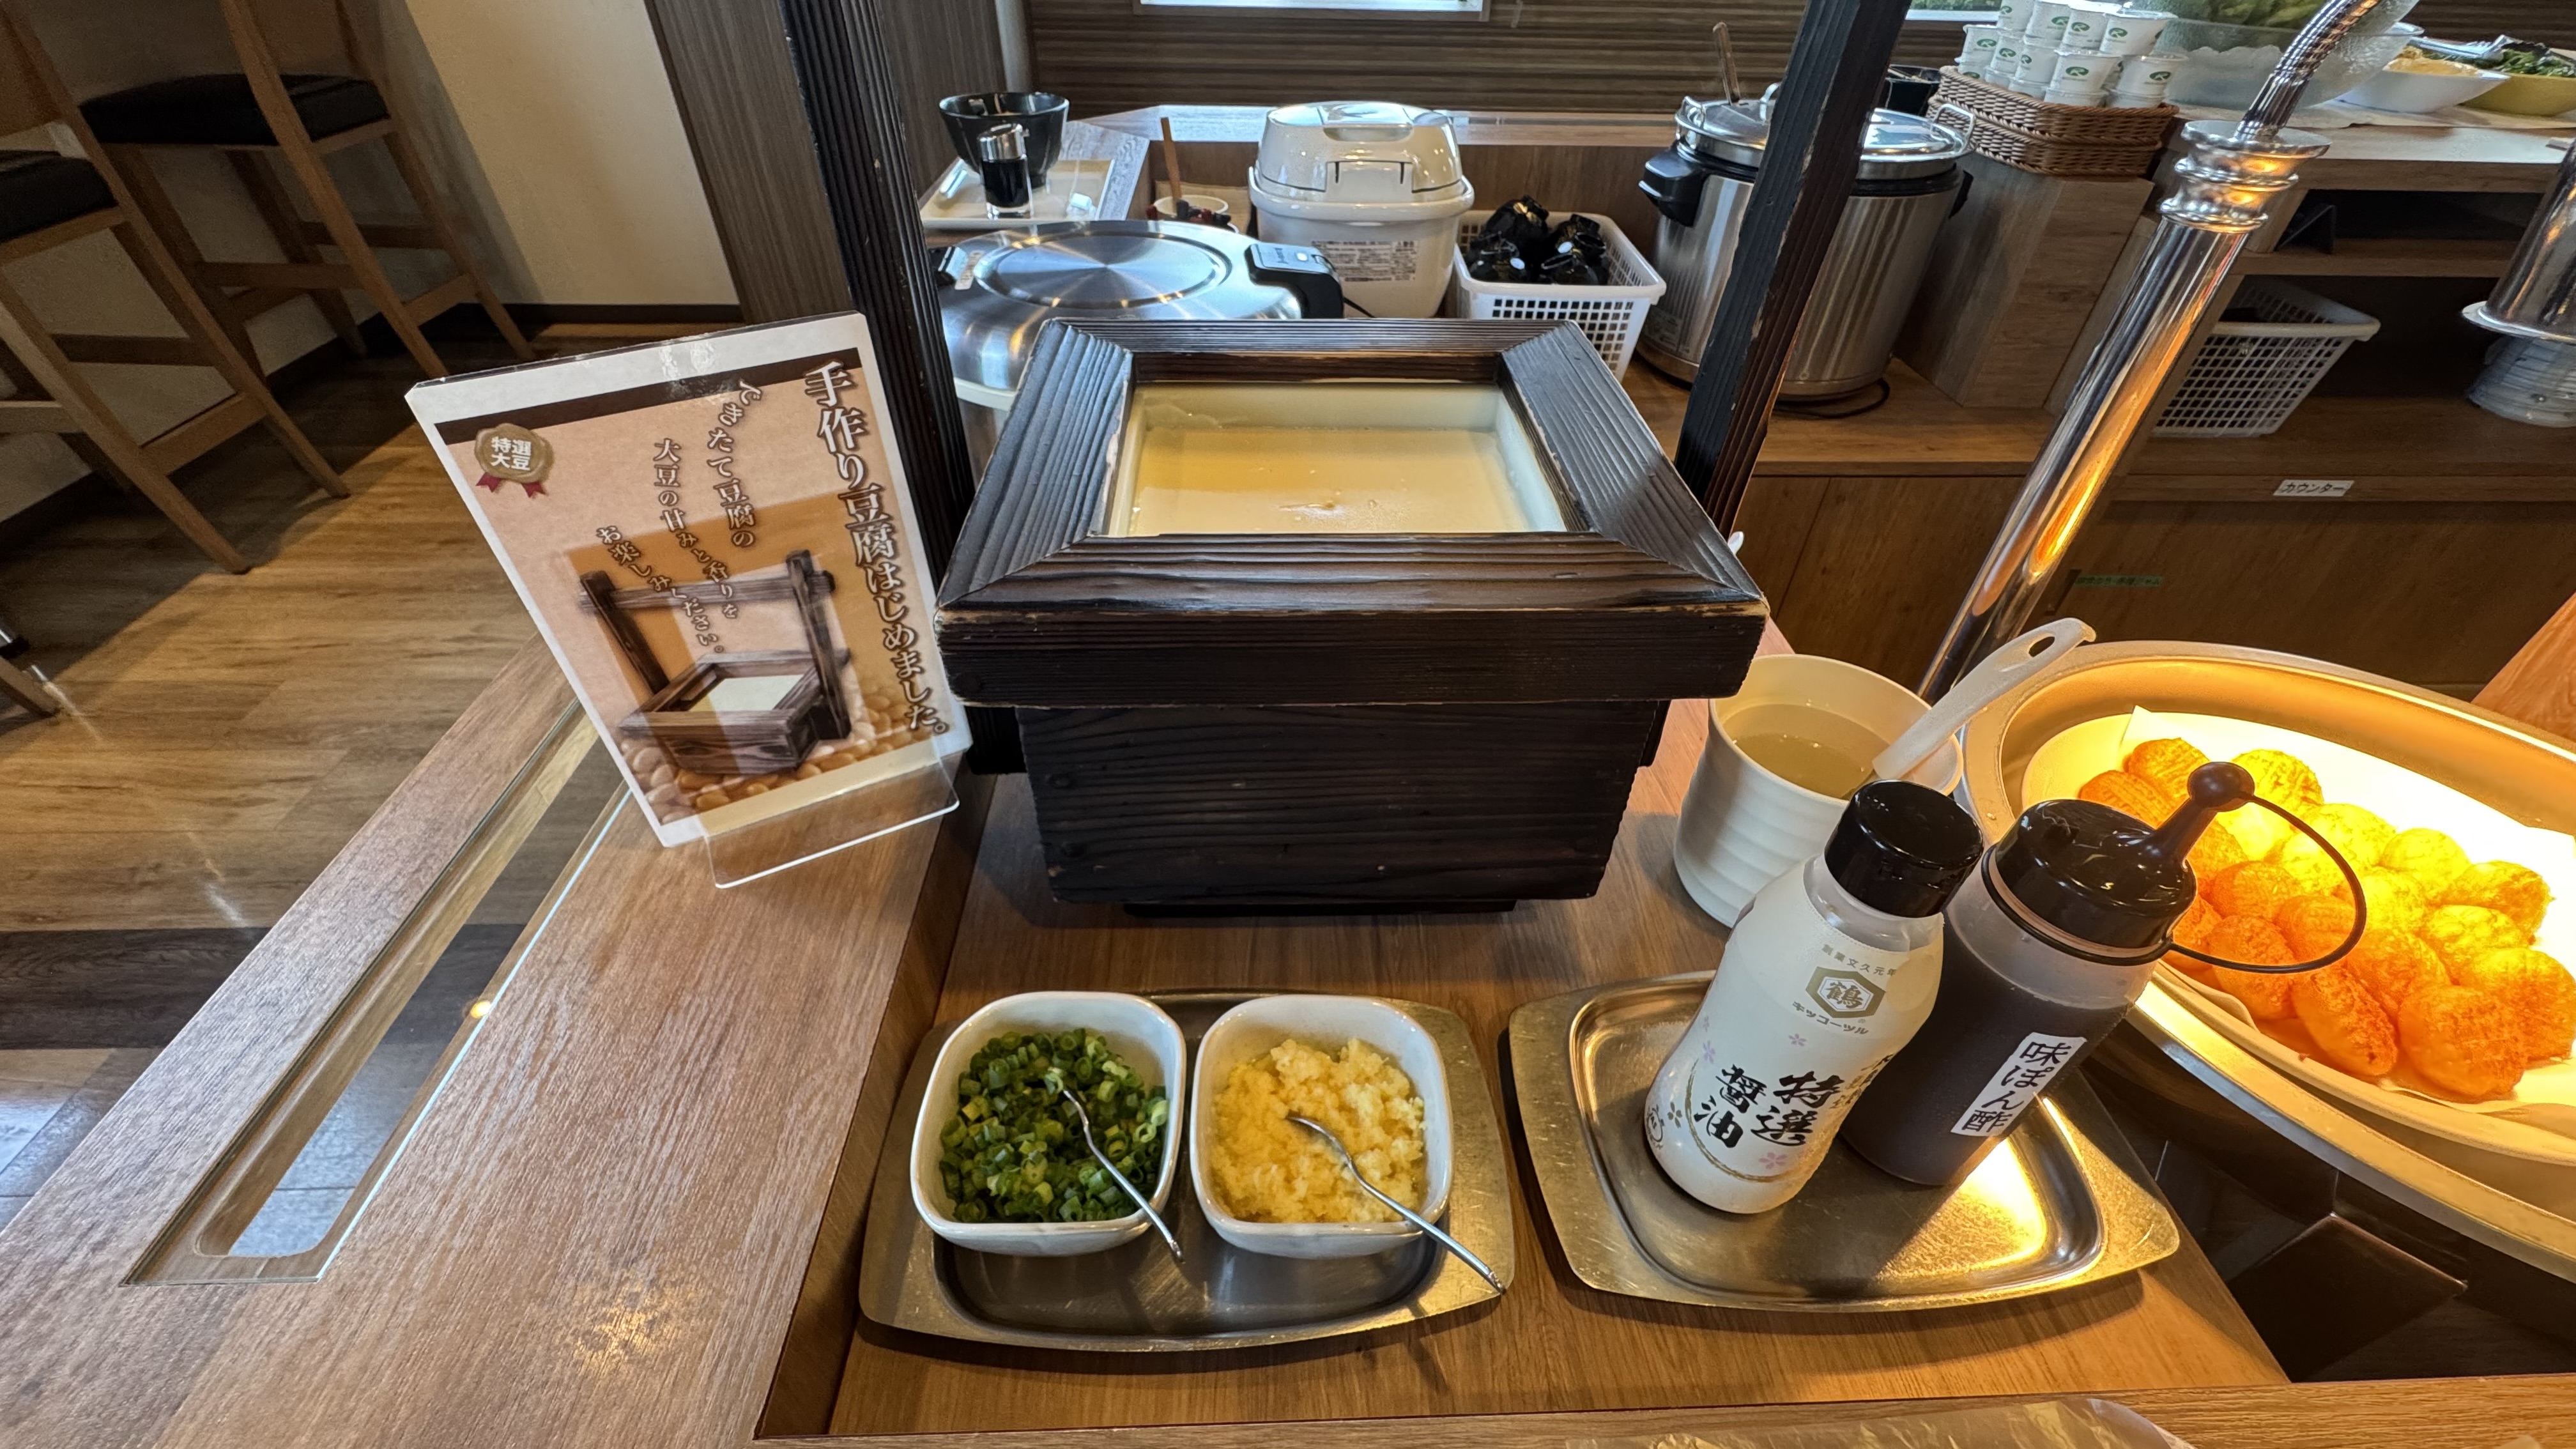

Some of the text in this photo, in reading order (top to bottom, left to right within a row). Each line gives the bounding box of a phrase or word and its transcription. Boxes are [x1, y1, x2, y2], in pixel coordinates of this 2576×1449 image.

[491, 452, 531, 471] 大豆
[707, 380, 762, 548] できたて豆腐の
[2280, 482, 2344, 493] カウンター
[654, 438, 737, 619] 大豆の甘みと香りを
[804, 360, 948, 734] 手作り豆腐はじめました。
[597, 525, 724, 653] お楽しみください。
[1792, 1000, 1869, 1035] キッコーツル
[1825, 981, 1864, 1009] 鶴
[1961, 1041, 2072, 1133] 味ぽん酢
